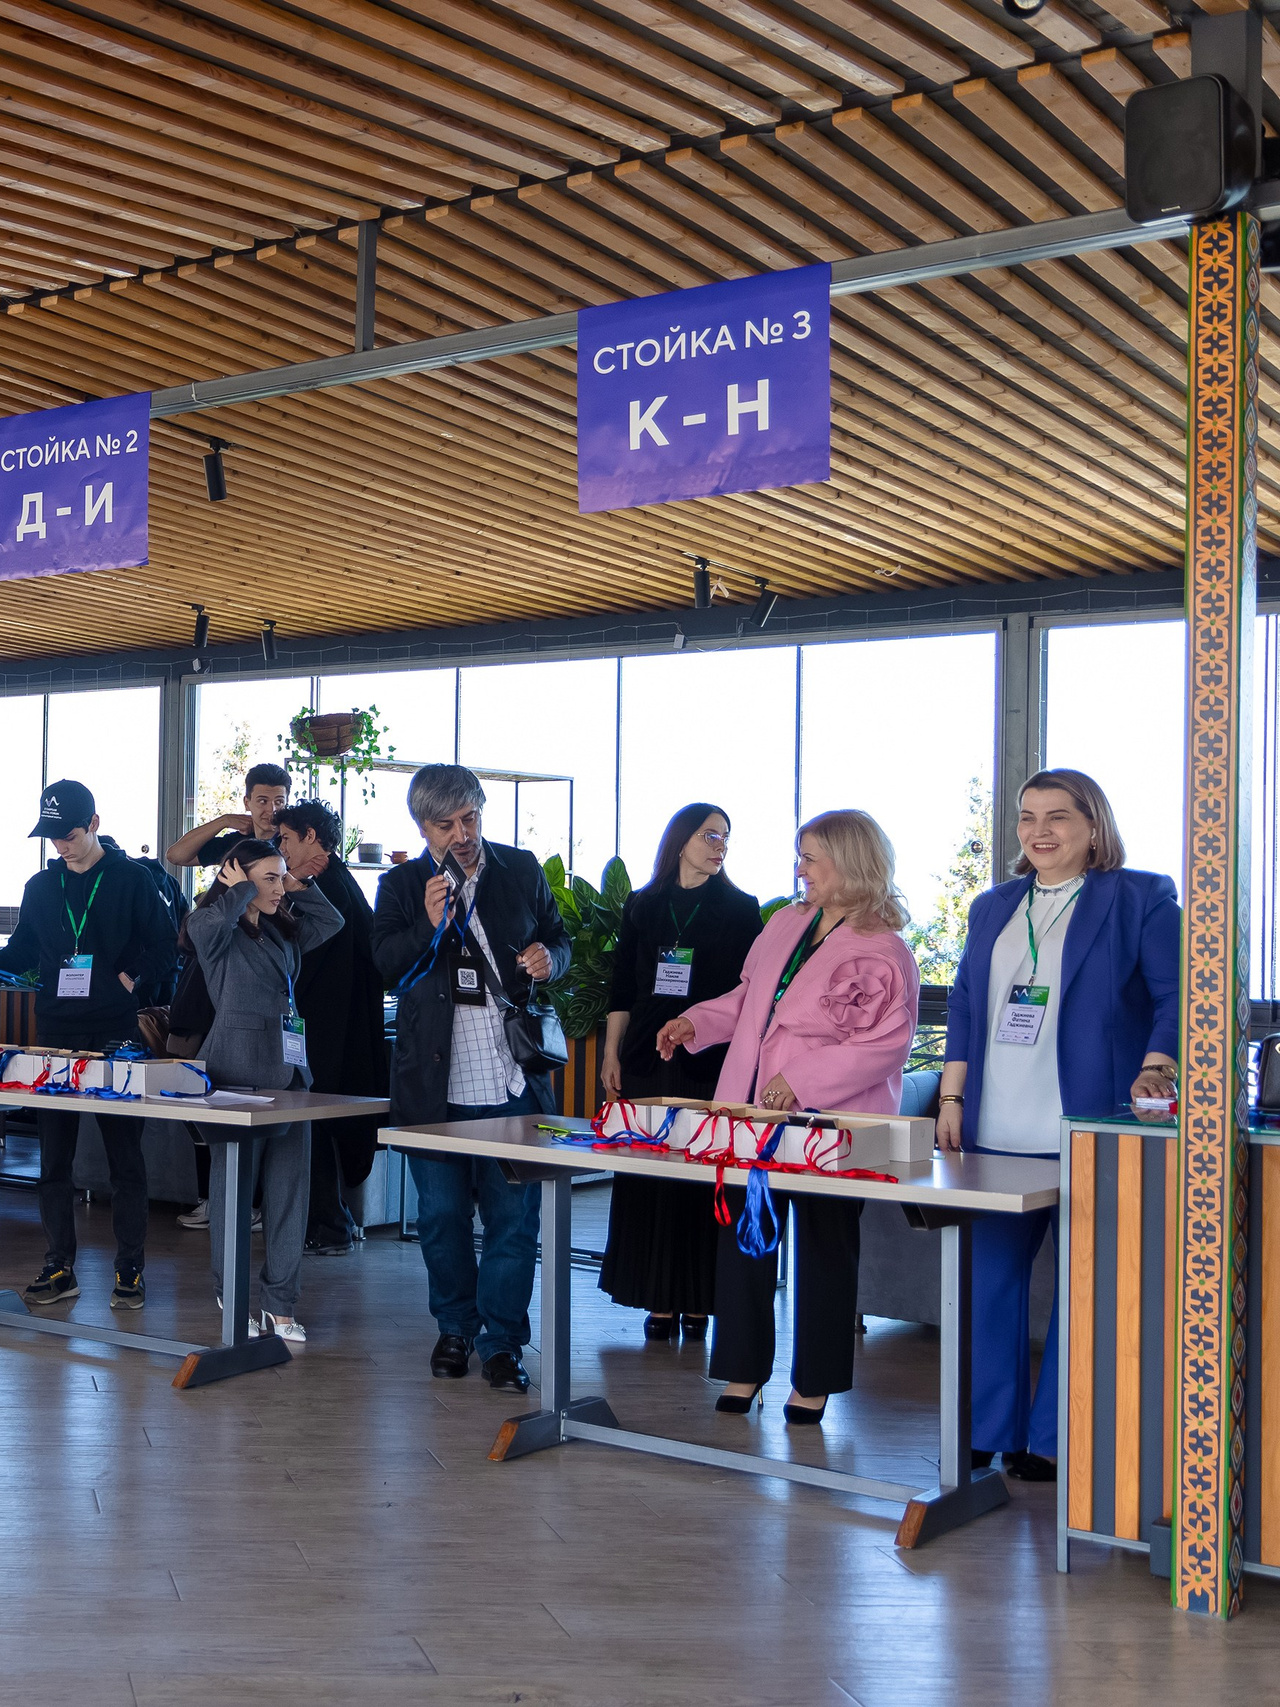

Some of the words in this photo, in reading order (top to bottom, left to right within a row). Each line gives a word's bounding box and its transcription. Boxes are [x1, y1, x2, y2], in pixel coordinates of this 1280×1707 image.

[593, 325, 736, 375] СТОЙКА
[745, 317, 783, 348] №
[792, 310, 811, 340] 3
[629, 396, 670, 450] К
[682, 413, 706, 426] -
[727, 378, 769, 436] Н
[0, 436, 91, 472] СТОЙКА
[96, 433, 120, 457] №
[125, 430, 138, 453] 2
[16, 492, 46, 542] Д
[56, 506, 71, 516] -
[85, 482, 113, 526] И
